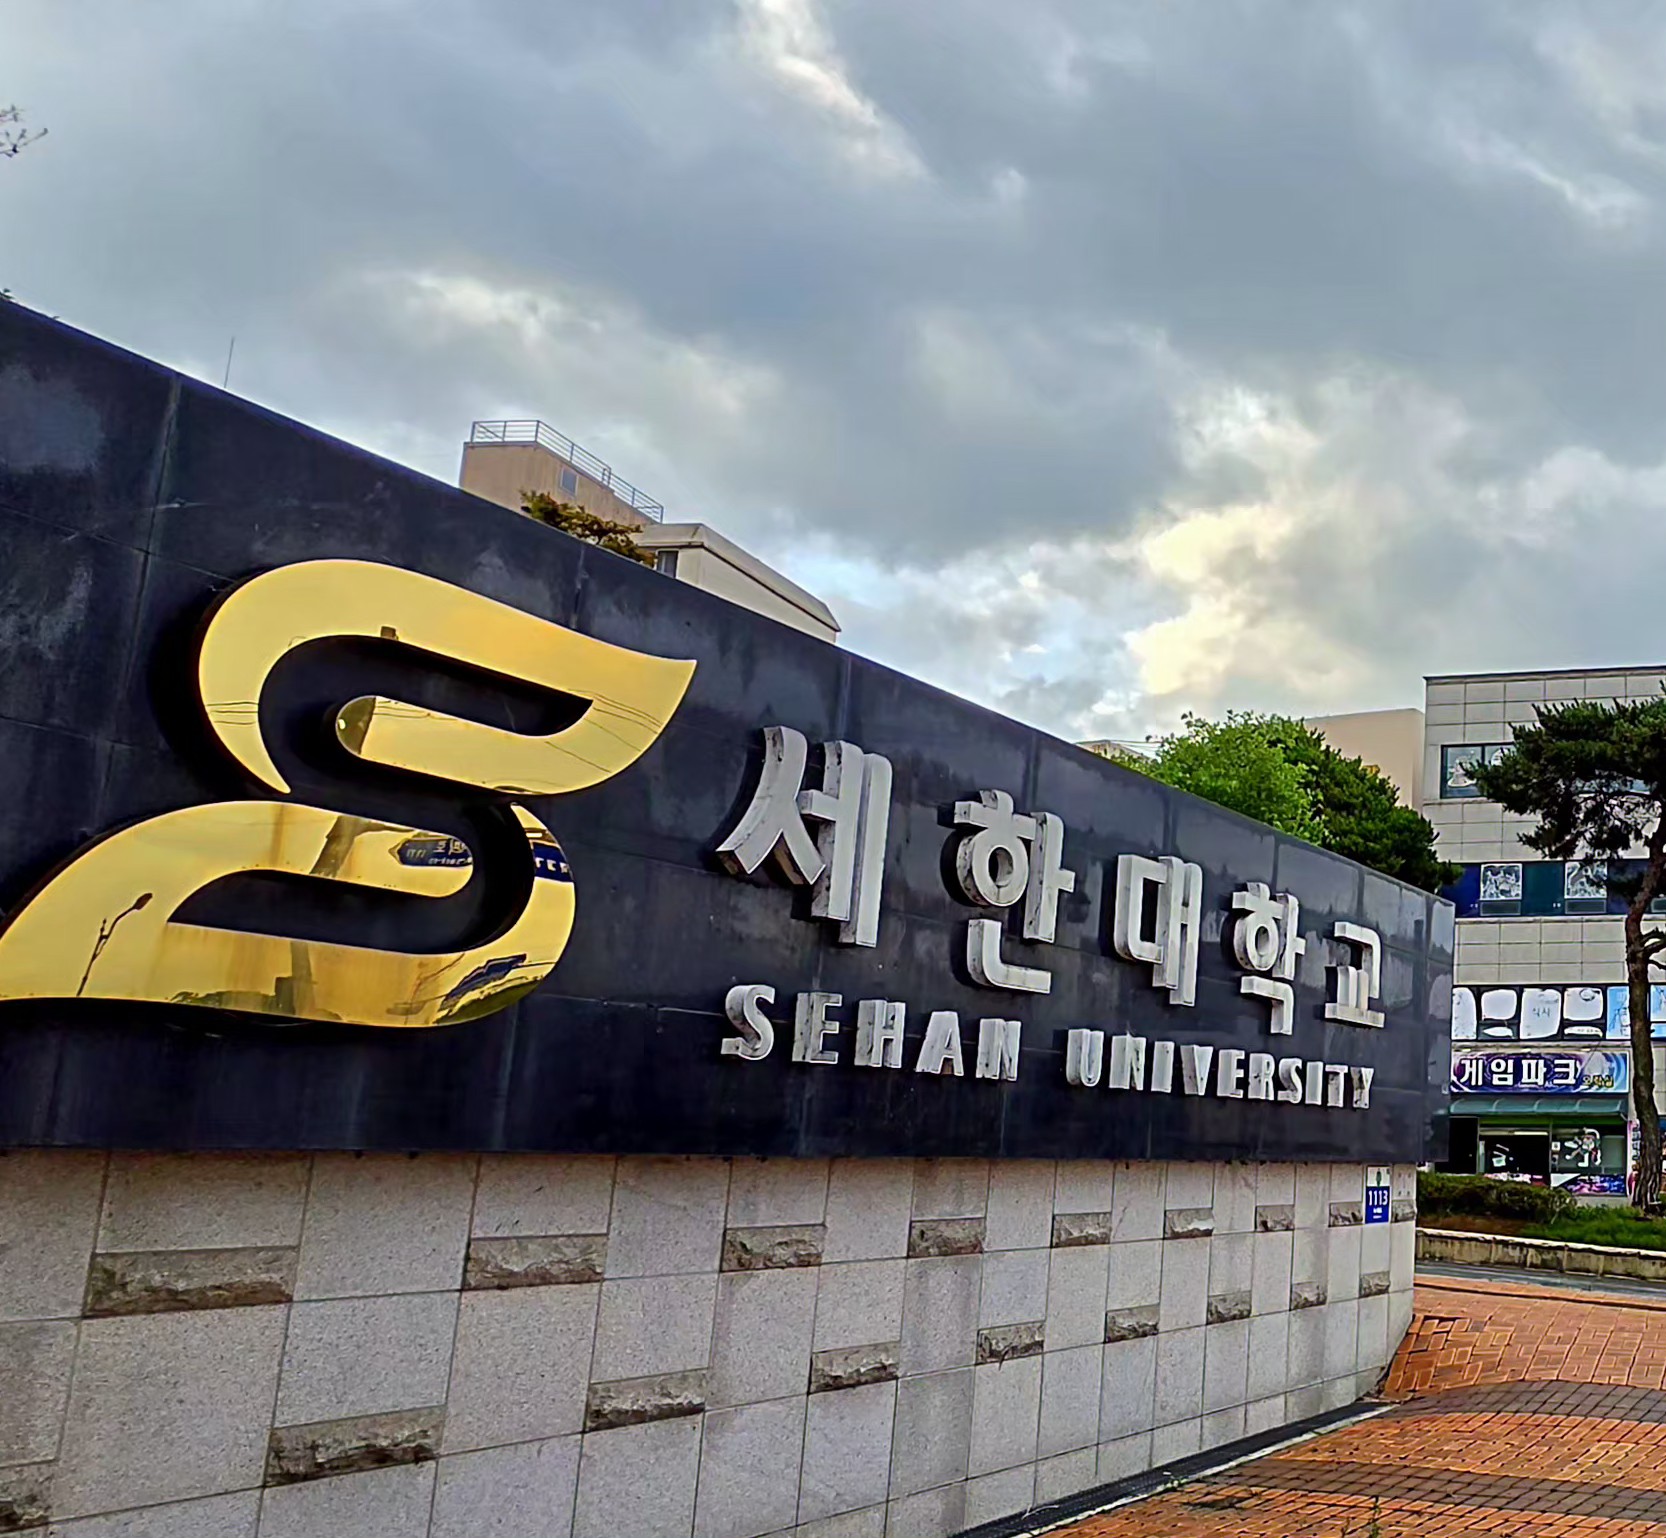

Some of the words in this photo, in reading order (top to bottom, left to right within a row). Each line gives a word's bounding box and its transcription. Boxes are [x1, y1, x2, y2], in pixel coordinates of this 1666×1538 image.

[716, 724, 1387, 1036] 세한대학교
[720, 984, 1024, 1083] SEHAN
[1064, 1027, 1376, 1110] UNIVERSITY
[1459, 1058, 1577, 1086] 게임파크
[1582, 1074, 1614, 1088] 오락실
[1368, 1189, 1389, 1206] 1113
